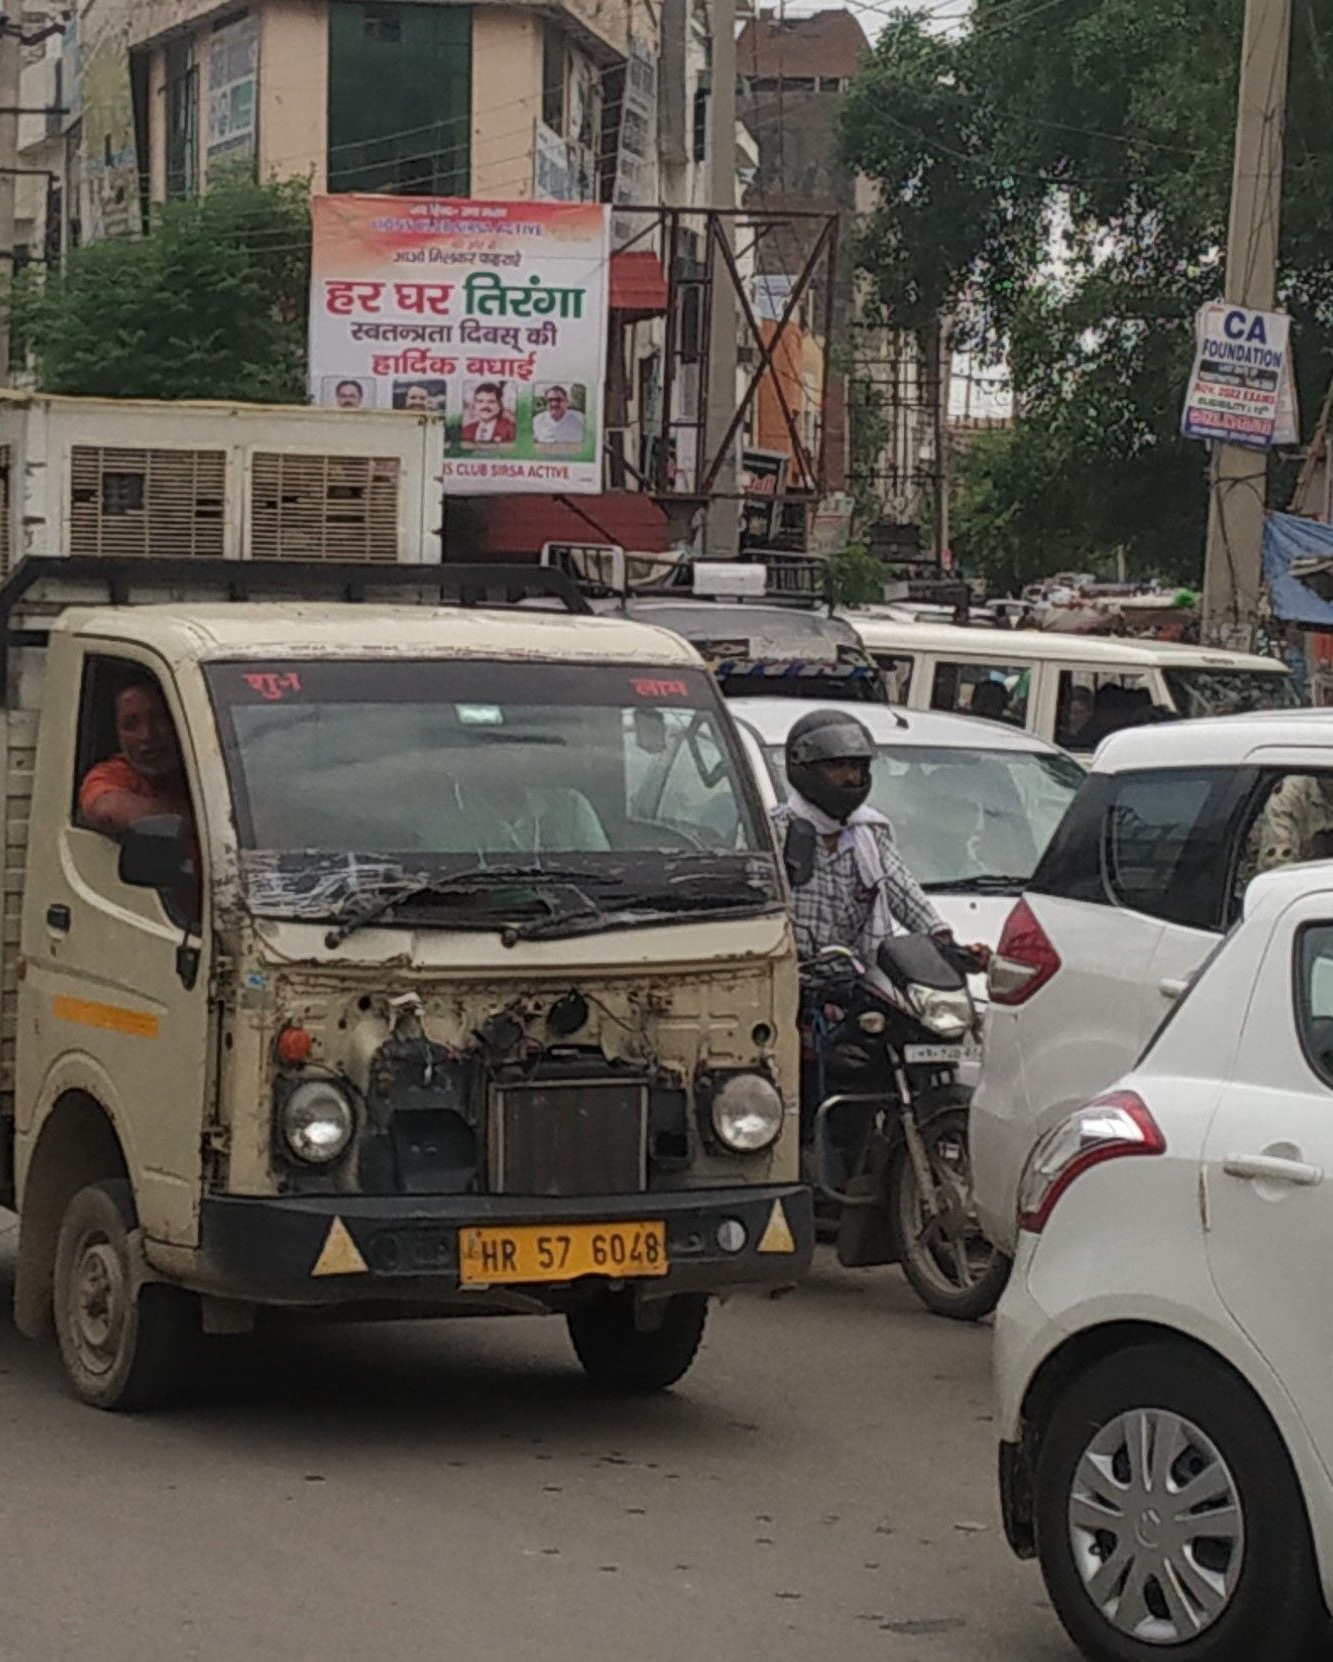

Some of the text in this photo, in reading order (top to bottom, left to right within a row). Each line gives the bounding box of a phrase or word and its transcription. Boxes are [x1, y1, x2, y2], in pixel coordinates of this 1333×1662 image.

[325, 272, 586, 318] हर घर तिरंगा
[526, 321, 557, 346] की
[1224, 310, 1267, 344] CA
[372, 348, 537, 380] हार्दिक बधाई
[1202, 338, 1283, 368] FOUNDATION
[456, 463, 488, 474] CLUB
[491, 464, 525, 477] SIRSA
[528, 466, 570, 480] ACTIVE
[481, 1232, 659, 1273] HR 57 6048
